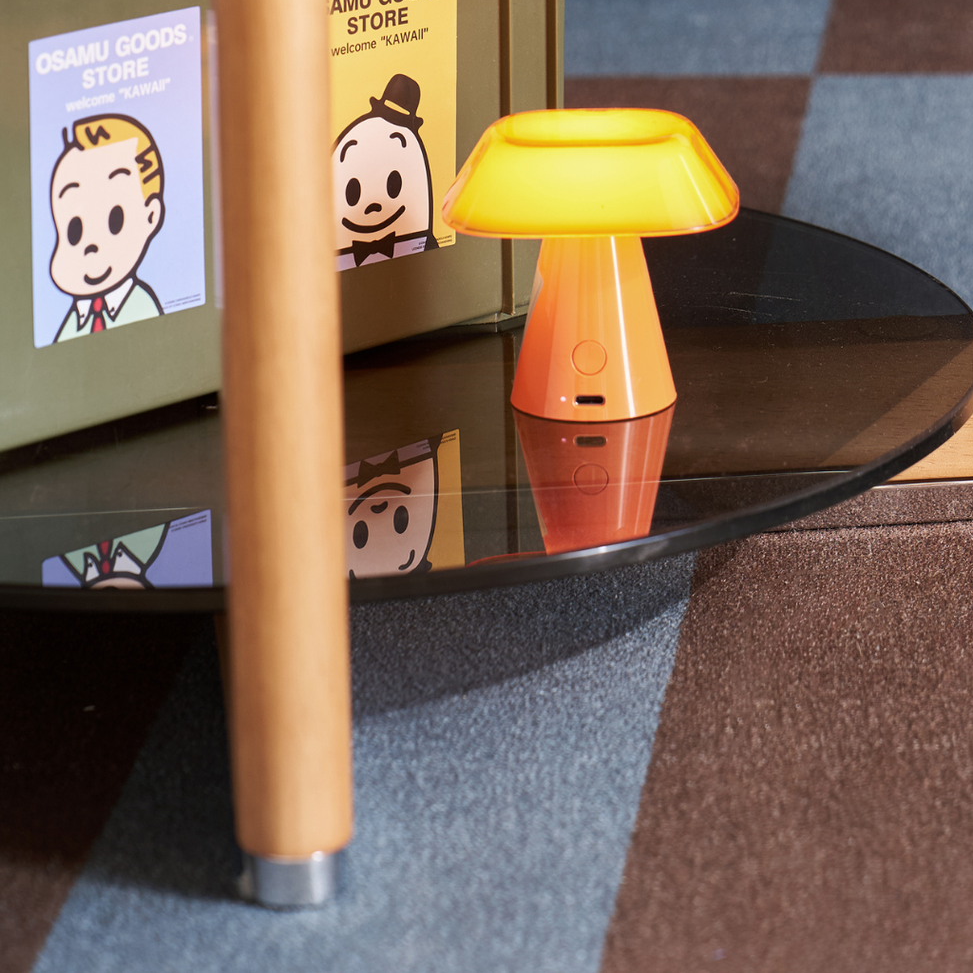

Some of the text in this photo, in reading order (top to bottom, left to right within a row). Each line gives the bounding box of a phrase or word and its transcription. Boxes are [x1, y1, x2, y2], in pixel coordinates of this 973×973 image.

[347, 7, 409, 35] STORE
[35, 24, 187, 75] OSAMU GOODS
[331, 40, 377, 57] welcome
[82, 57, 149, 89] STORE
[65, 92, 115, 113] welcome
